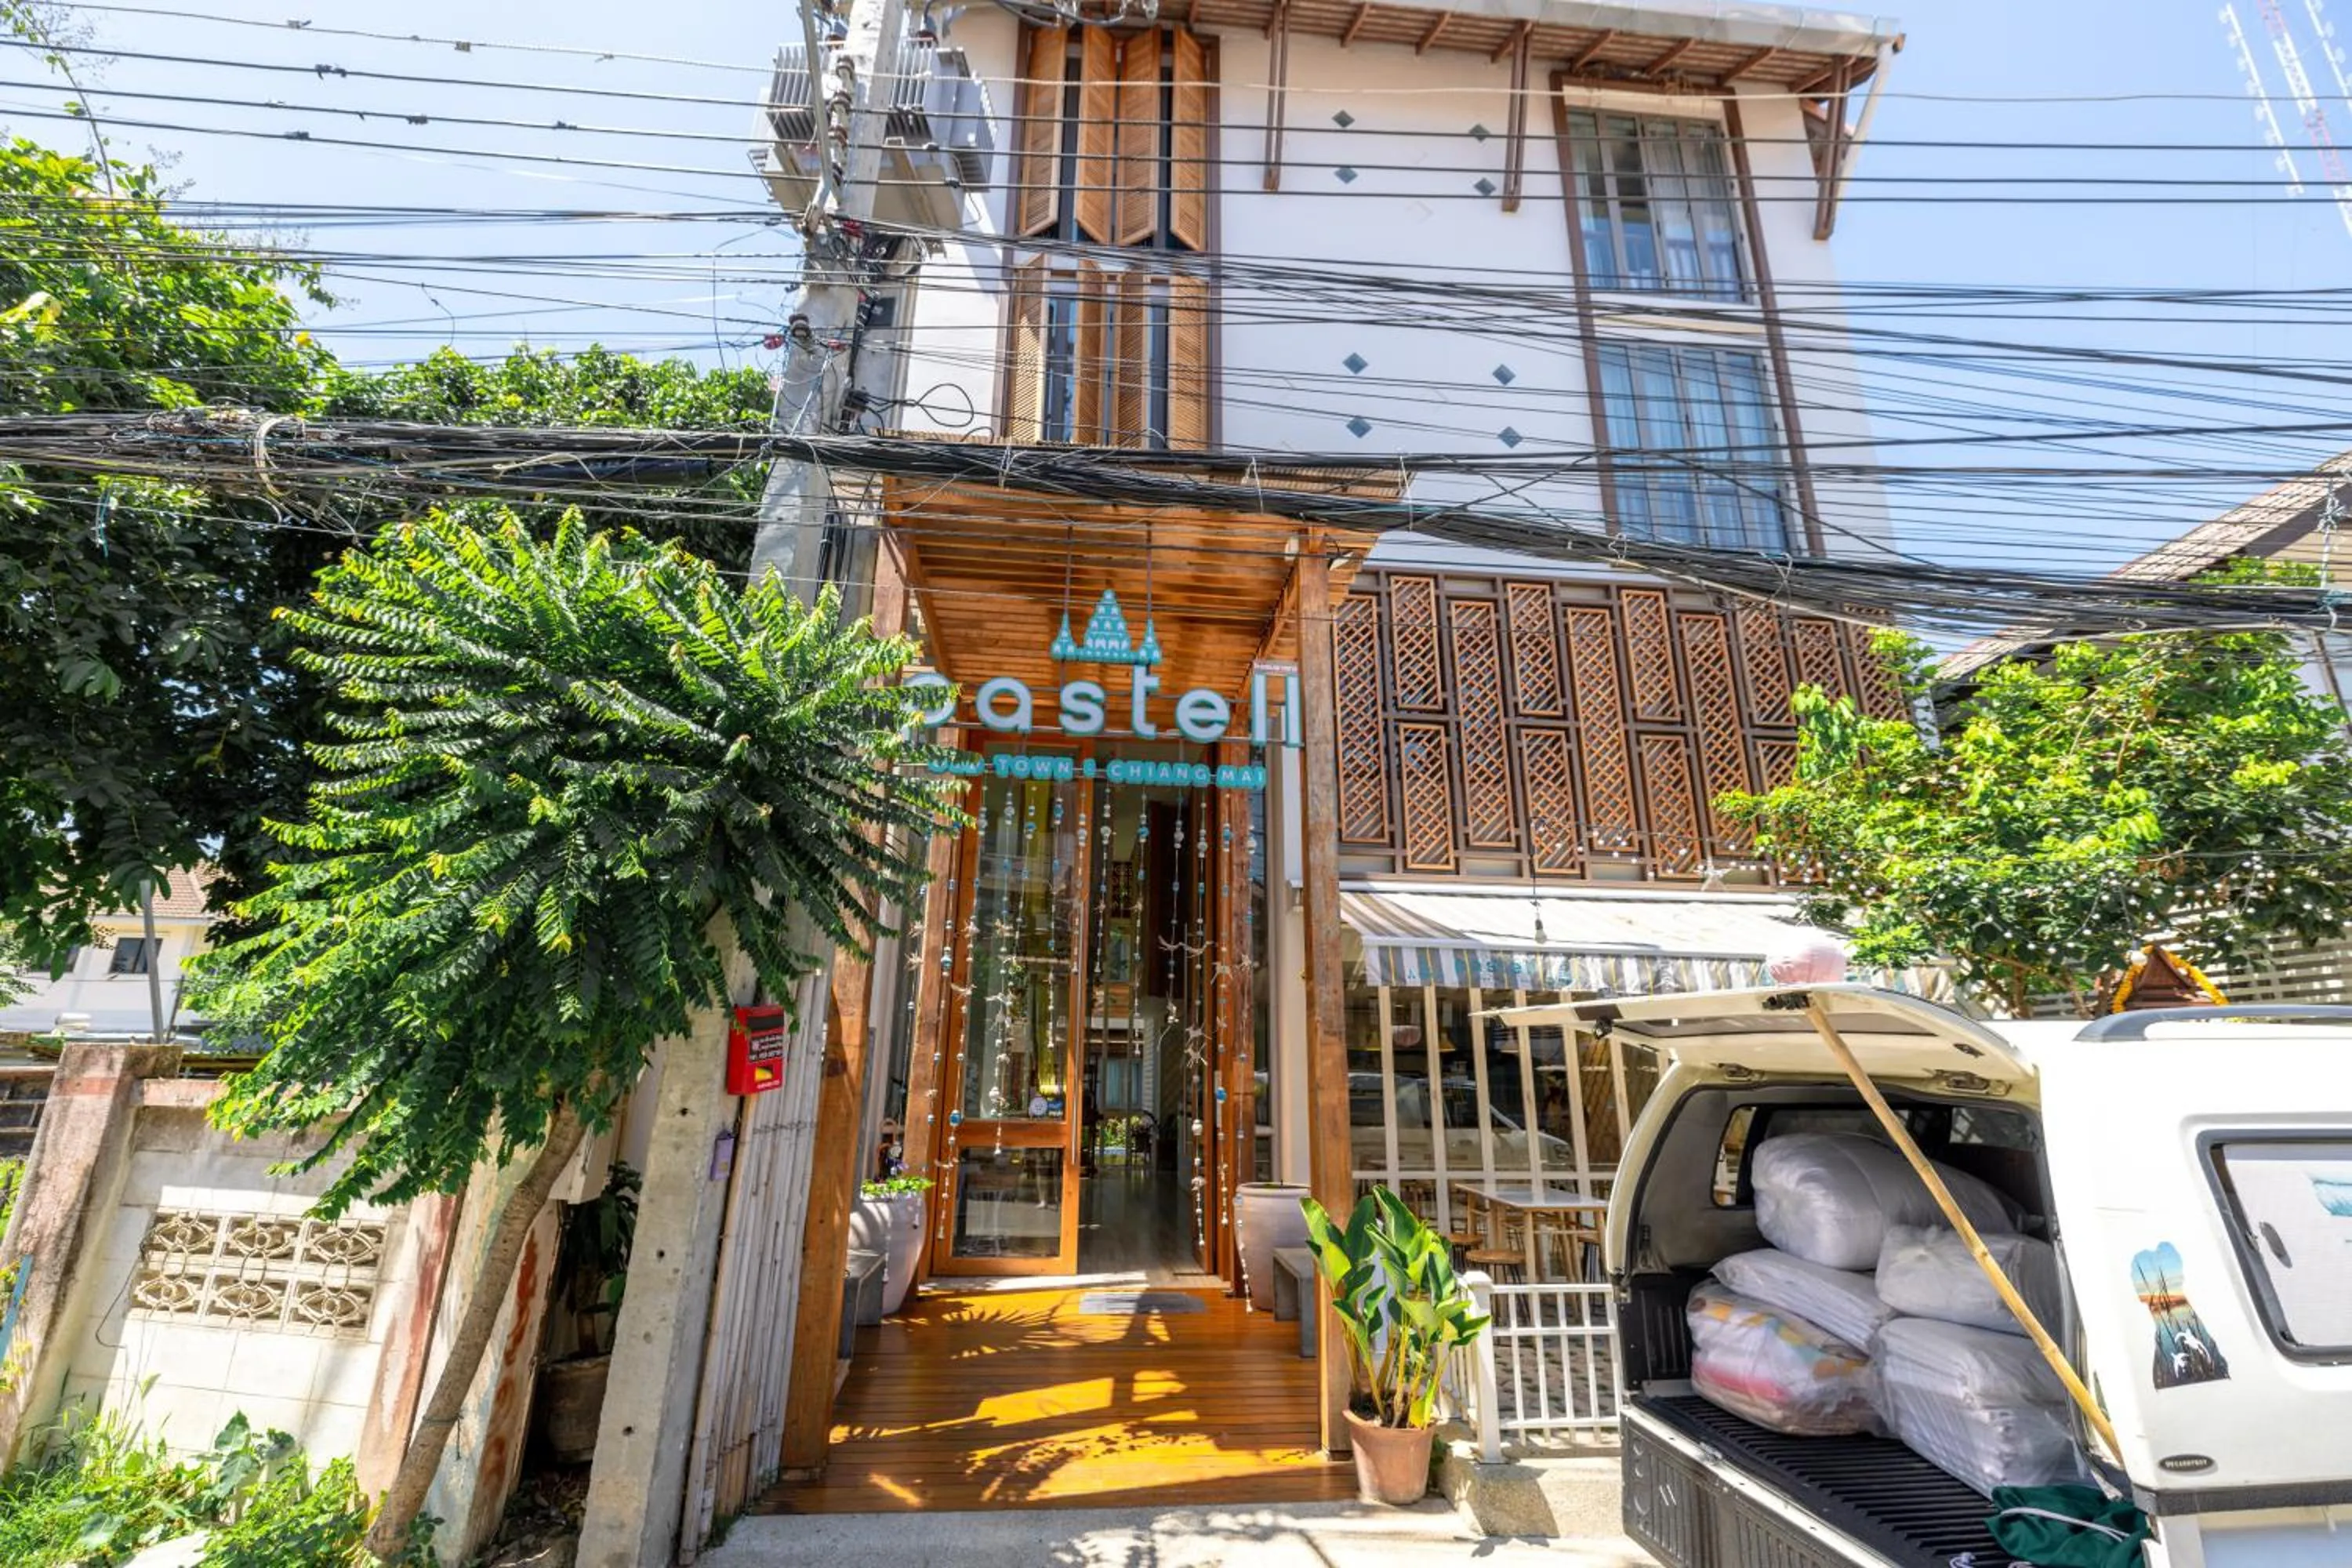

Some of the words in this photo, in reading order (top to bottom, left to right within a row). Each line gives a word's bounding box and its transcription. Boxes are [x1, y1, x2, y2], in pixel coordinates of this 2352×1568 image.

[996, 755, 1071, 775] TOWN
[1109, 761, 1208, 782] CHIANG
[1219, 768, 1265, 785] MAI
